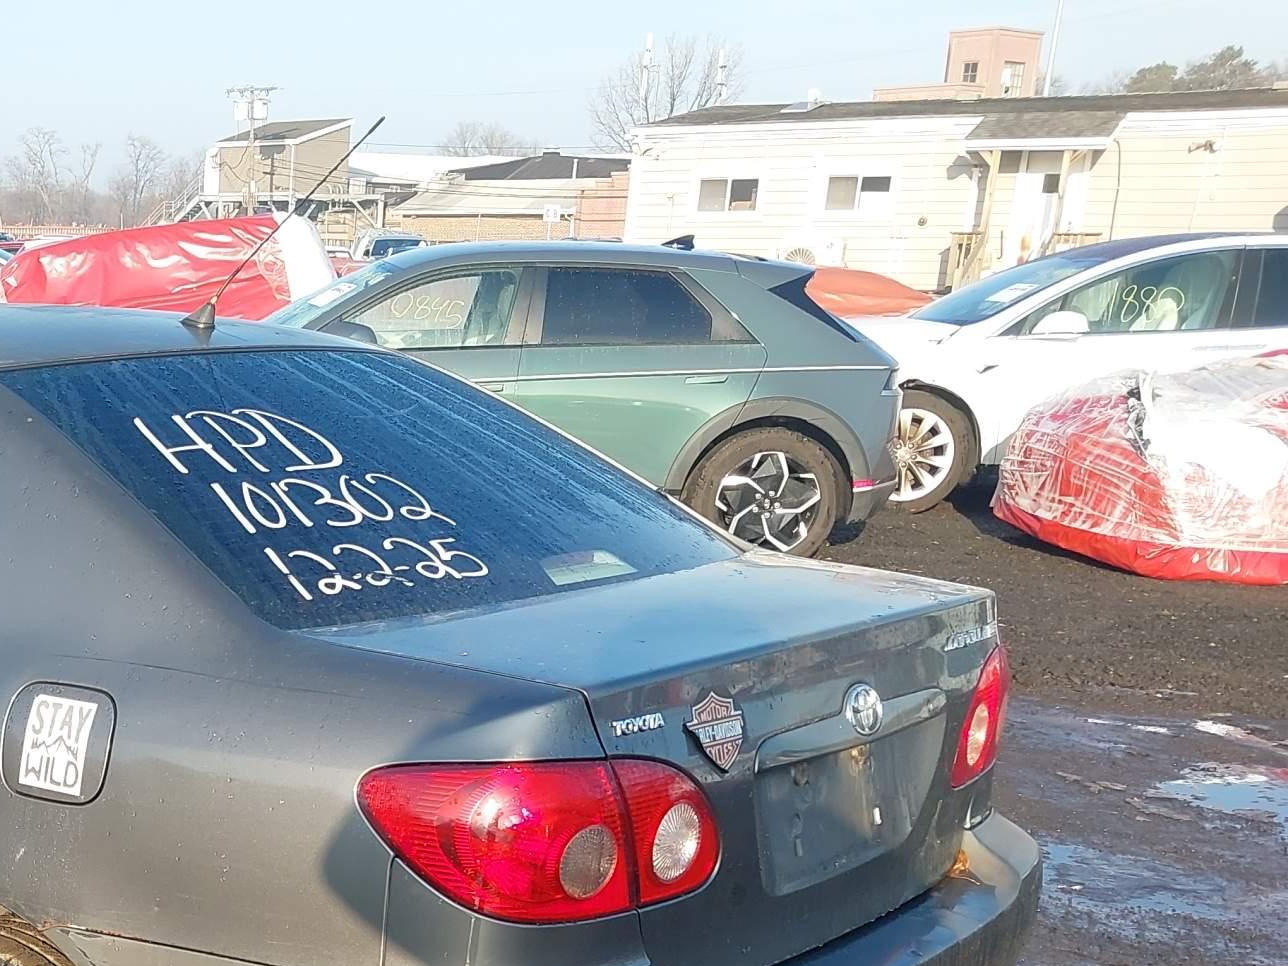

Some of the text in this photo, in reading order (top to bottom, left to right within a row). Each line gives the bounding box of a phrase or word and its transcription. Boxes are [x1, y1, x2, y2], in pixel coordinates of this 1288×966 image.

[391, 293, 465, 328] 0845
[133, 408, 343, 474] HPD
[210, 473, 457, 534] 101302
[31, 700, 93, 744] STAY
[612, 712, 665, 737] TOYOTA
[699, 705, 728, 722] MOTOR
[24, 751, 79, 788] WILD
[707, 743, 733, 765] CYCLES
